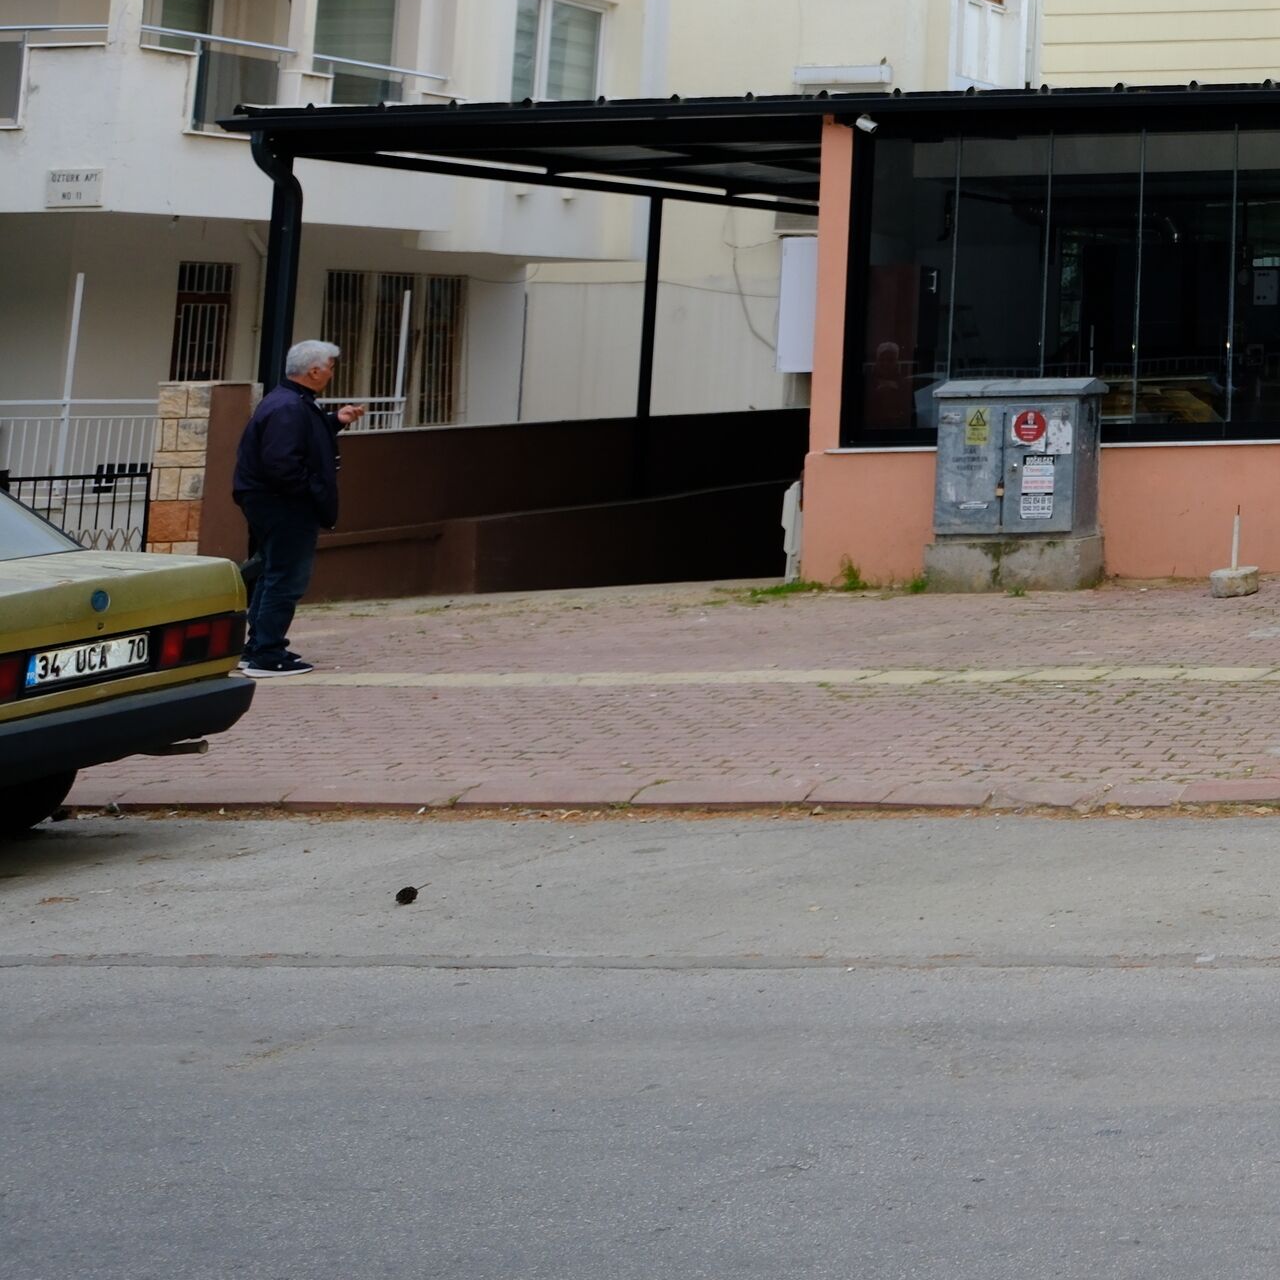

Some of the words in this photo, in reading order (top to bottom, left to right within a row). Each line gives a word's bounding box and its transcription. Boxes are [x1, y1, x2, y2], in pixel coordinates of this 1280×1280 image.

[38, 654, 60, 680] 34
[76, 645, 108, 673] UCA
[128, 638, 145, 663] 70
